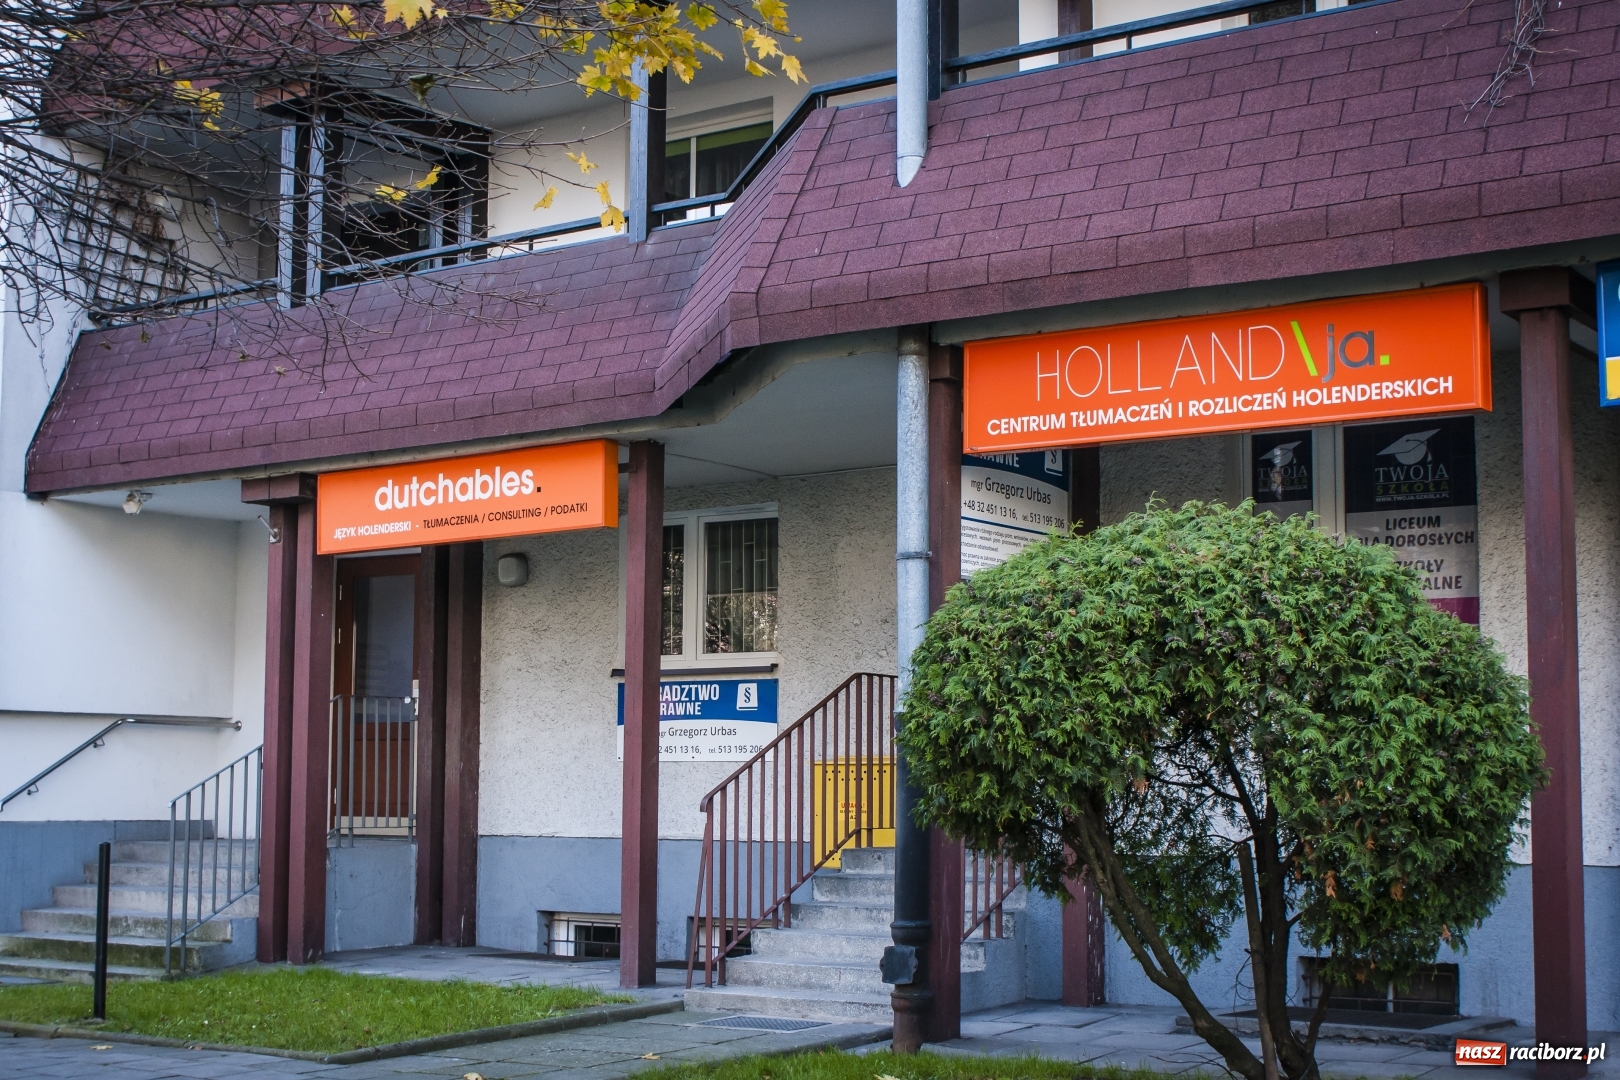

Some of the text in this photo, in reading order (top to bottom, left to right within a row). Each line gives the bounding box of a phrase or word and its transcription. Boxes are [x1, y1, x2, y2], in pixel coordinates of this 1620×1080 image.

[987, 376, 1453, 436] CENTRUM TŁUMACZEŃ I ROZLICZEŃ HOLENDERSKICH
[1375, 463, 1449, 483] TWOJA
[374, 466, 542, 511] dutchables.
[970, 477, 1052, 505] mgr Grzegorz Urbas
[1376, 481, 1450, 495] SZKOŁA
[333, 526, 357, 540] JĘZYK
[357, 521, 412, 536] HOLENDERSKI
[423, 514, 479, 529] TŁUMACZENIA
[487, 507, 542, 522] CONSULTING
[550, 502, 588, 516] PODATKI
[963, 500, 976, 511] +48
[976, 501, 985, 513] 32
[986, 503, 997, 515] 451
[999, 506, 1007, 517] 13
[1029, 512, 1041, 524] 513
[1042, 515, 1053, 527] 195
[1054, 517, 1065, 529] 206
[1385, 515, 1441, 531] LICEUM
[1385, 531, 1475, 547] DOROSŁYCH
[660, 684, 720, 702] ADZTWO
[660, 702, 702, 716] RAWNE
[668, 727, 708, 739] Grzegorz
[710, 726, 737, 736] Urbas
[664, 746, 677, 754] 451
[680, 746, 689, 754] 13
[718, 746, 732, 754] 513
[734, 745, 748, 754] 195
[749, 745, 763, 754] 206
